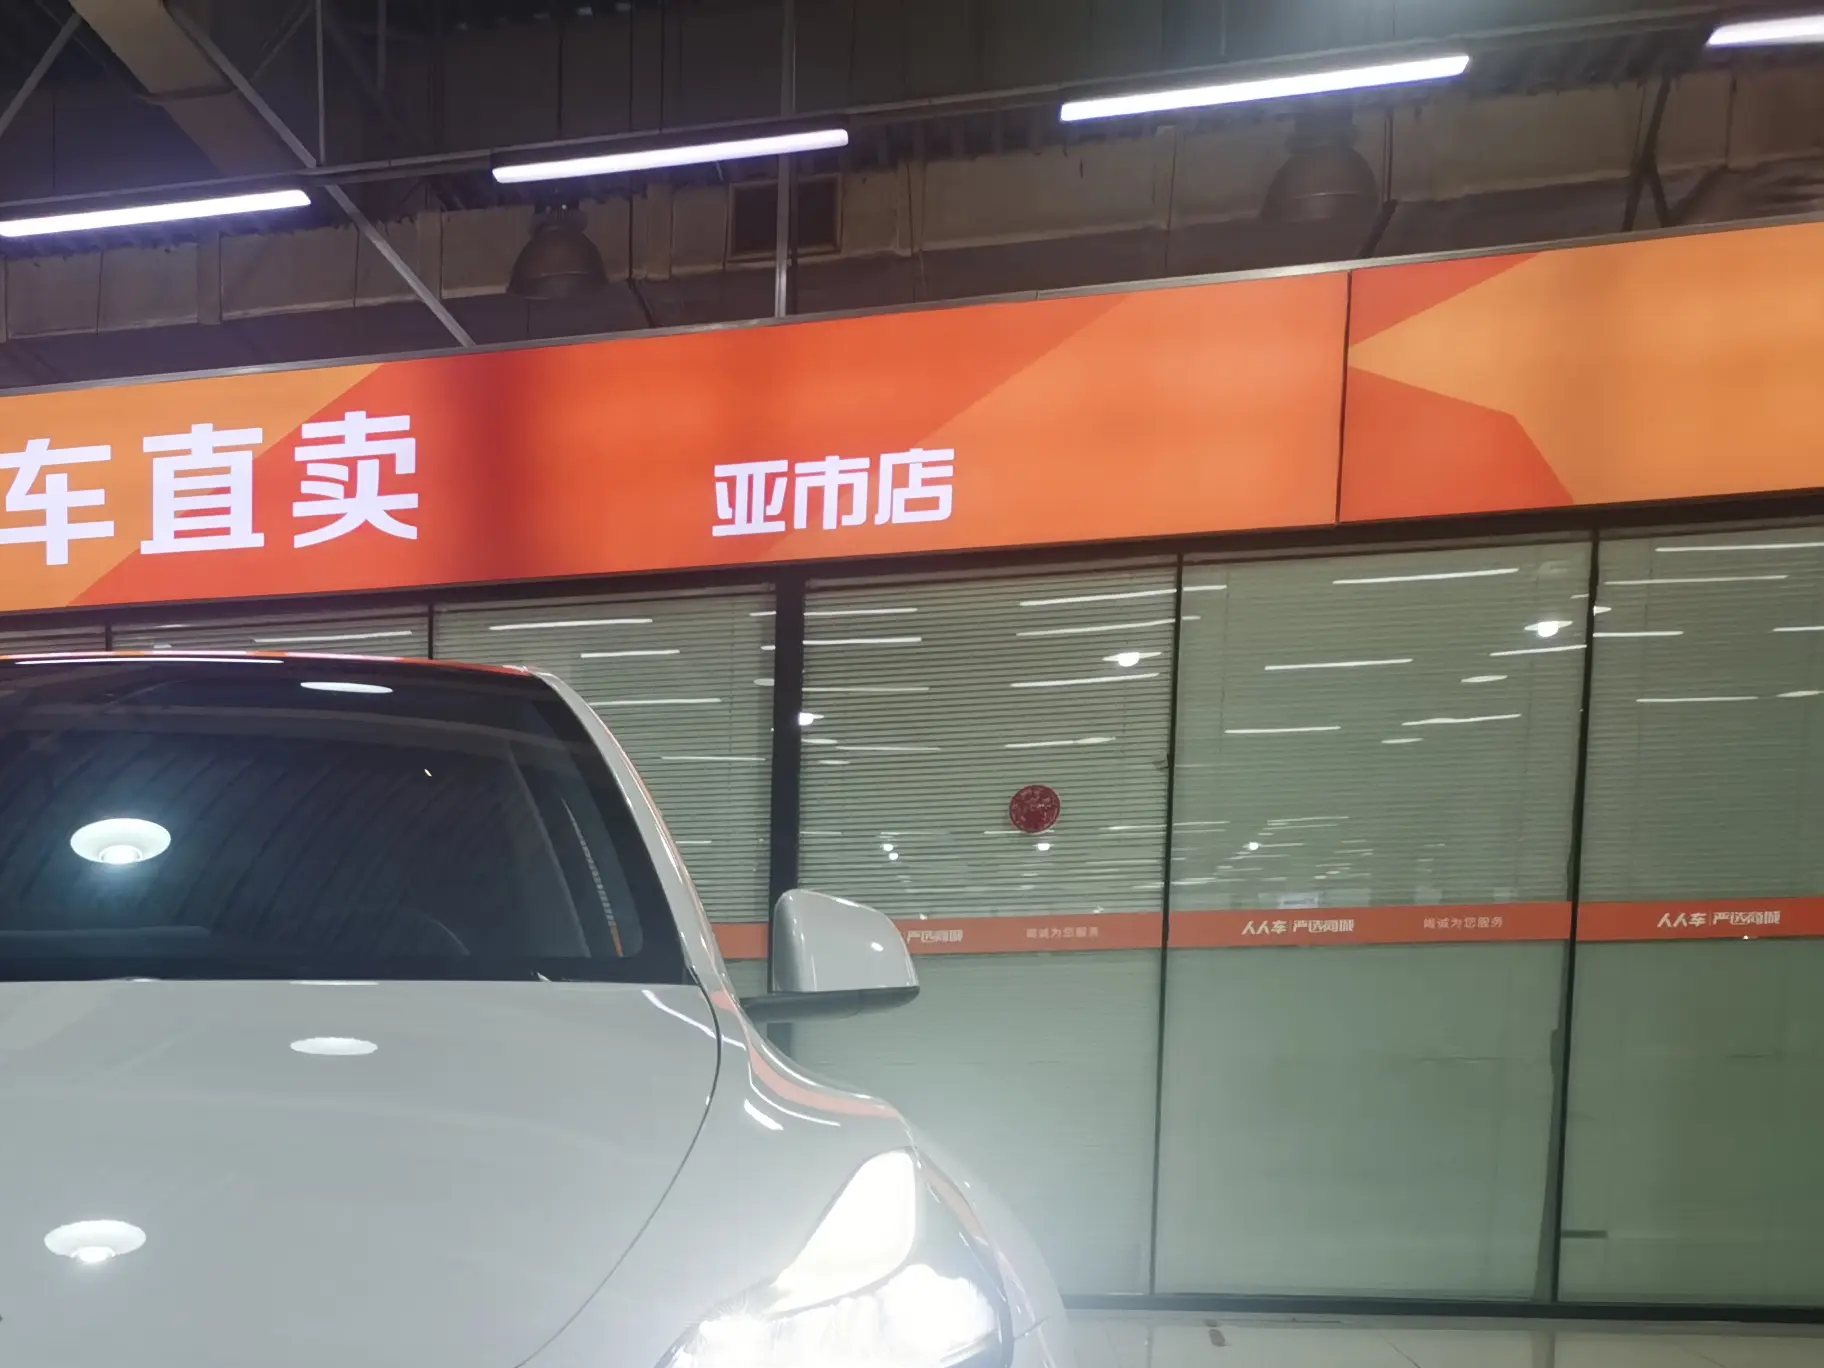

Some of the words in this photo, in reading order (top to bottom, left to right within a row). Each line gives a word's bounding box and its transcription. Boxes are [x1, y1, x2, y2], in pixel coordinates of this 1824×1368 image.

[712, 448, 954, 537] 亚市店
[1241, 919, 1288, 936] 人人车
[1657, 912, 1708, 928] 人人车
